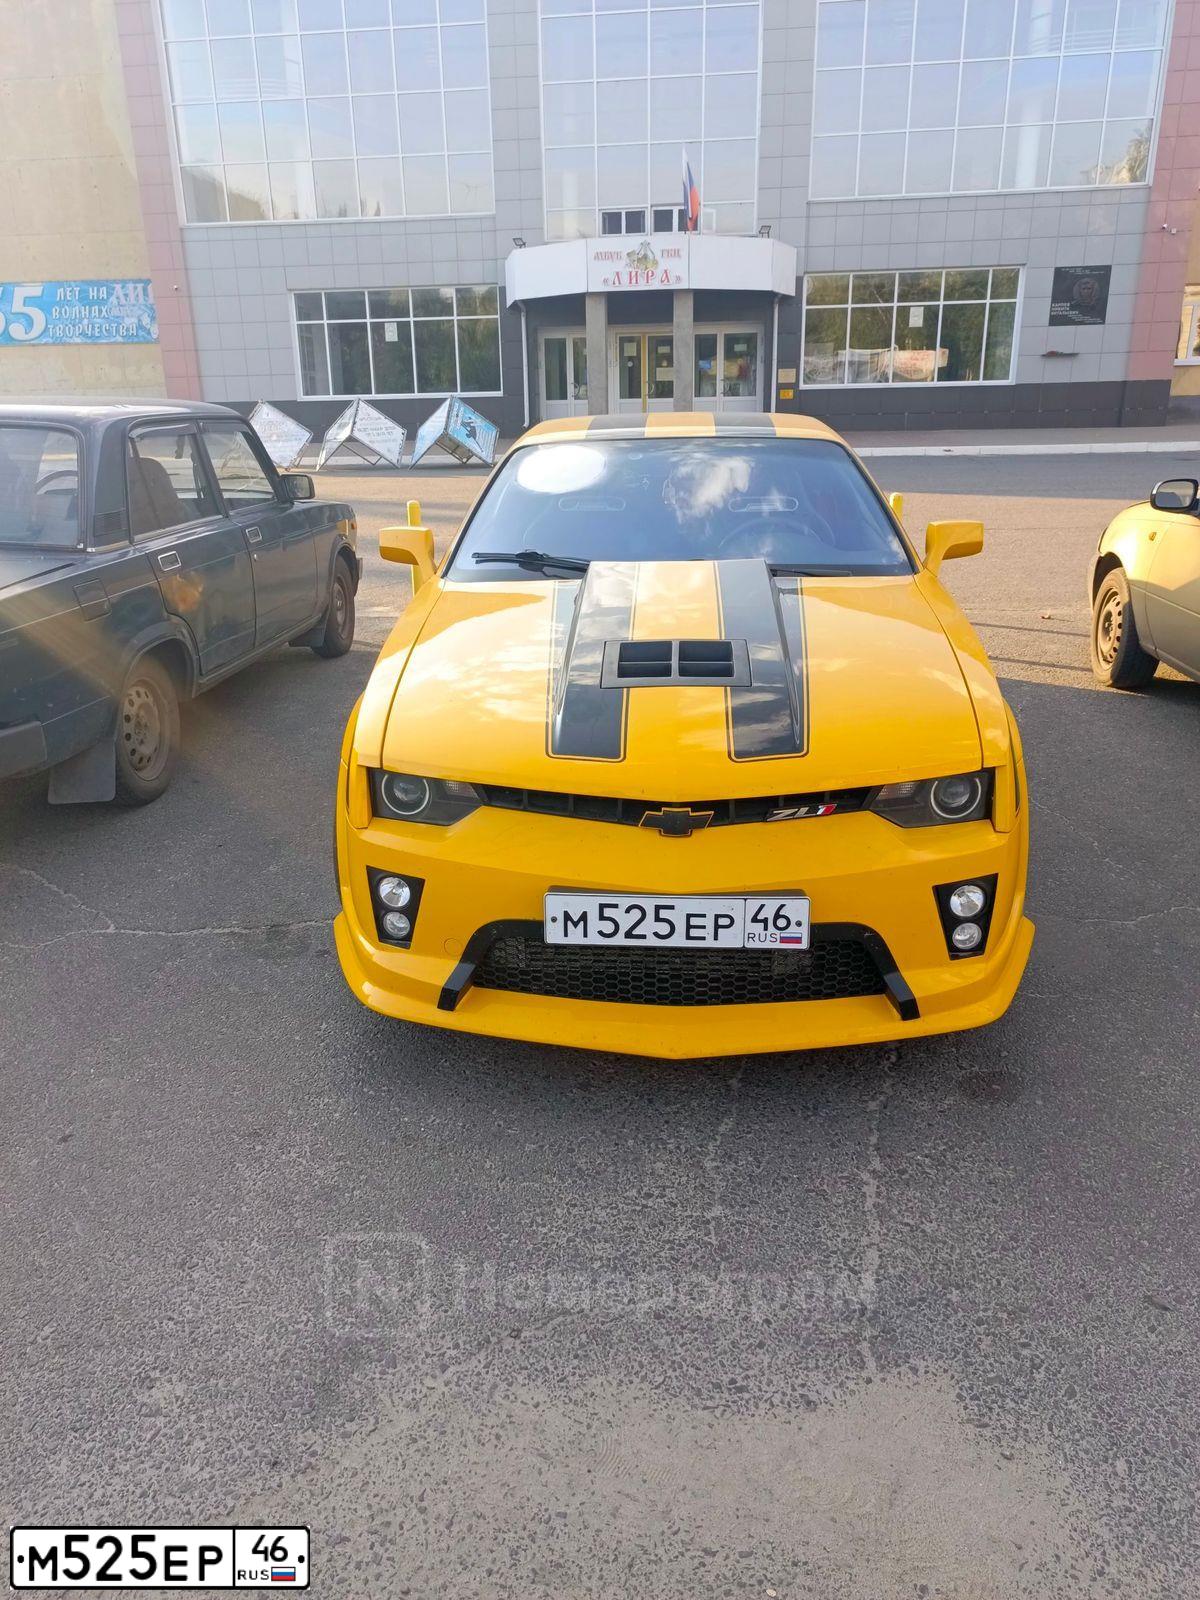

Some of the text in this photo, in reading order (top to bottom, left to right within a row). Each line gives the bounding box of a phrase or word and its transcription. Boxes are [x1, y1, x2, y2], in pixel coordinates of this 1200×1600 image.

[57, 286, 108, 301] ЛЕТ НА
[52, 304, 109, 319] ВОЛНАХ
[48, 322, 137, 338] ТВОРЧЕСТВА
[767, 803, 838, 821] ZL1
[562, 902, 736, 942] М525ЕР
[750, 903, 792, 932] 46
[747, 932, 778, 944] RUS
